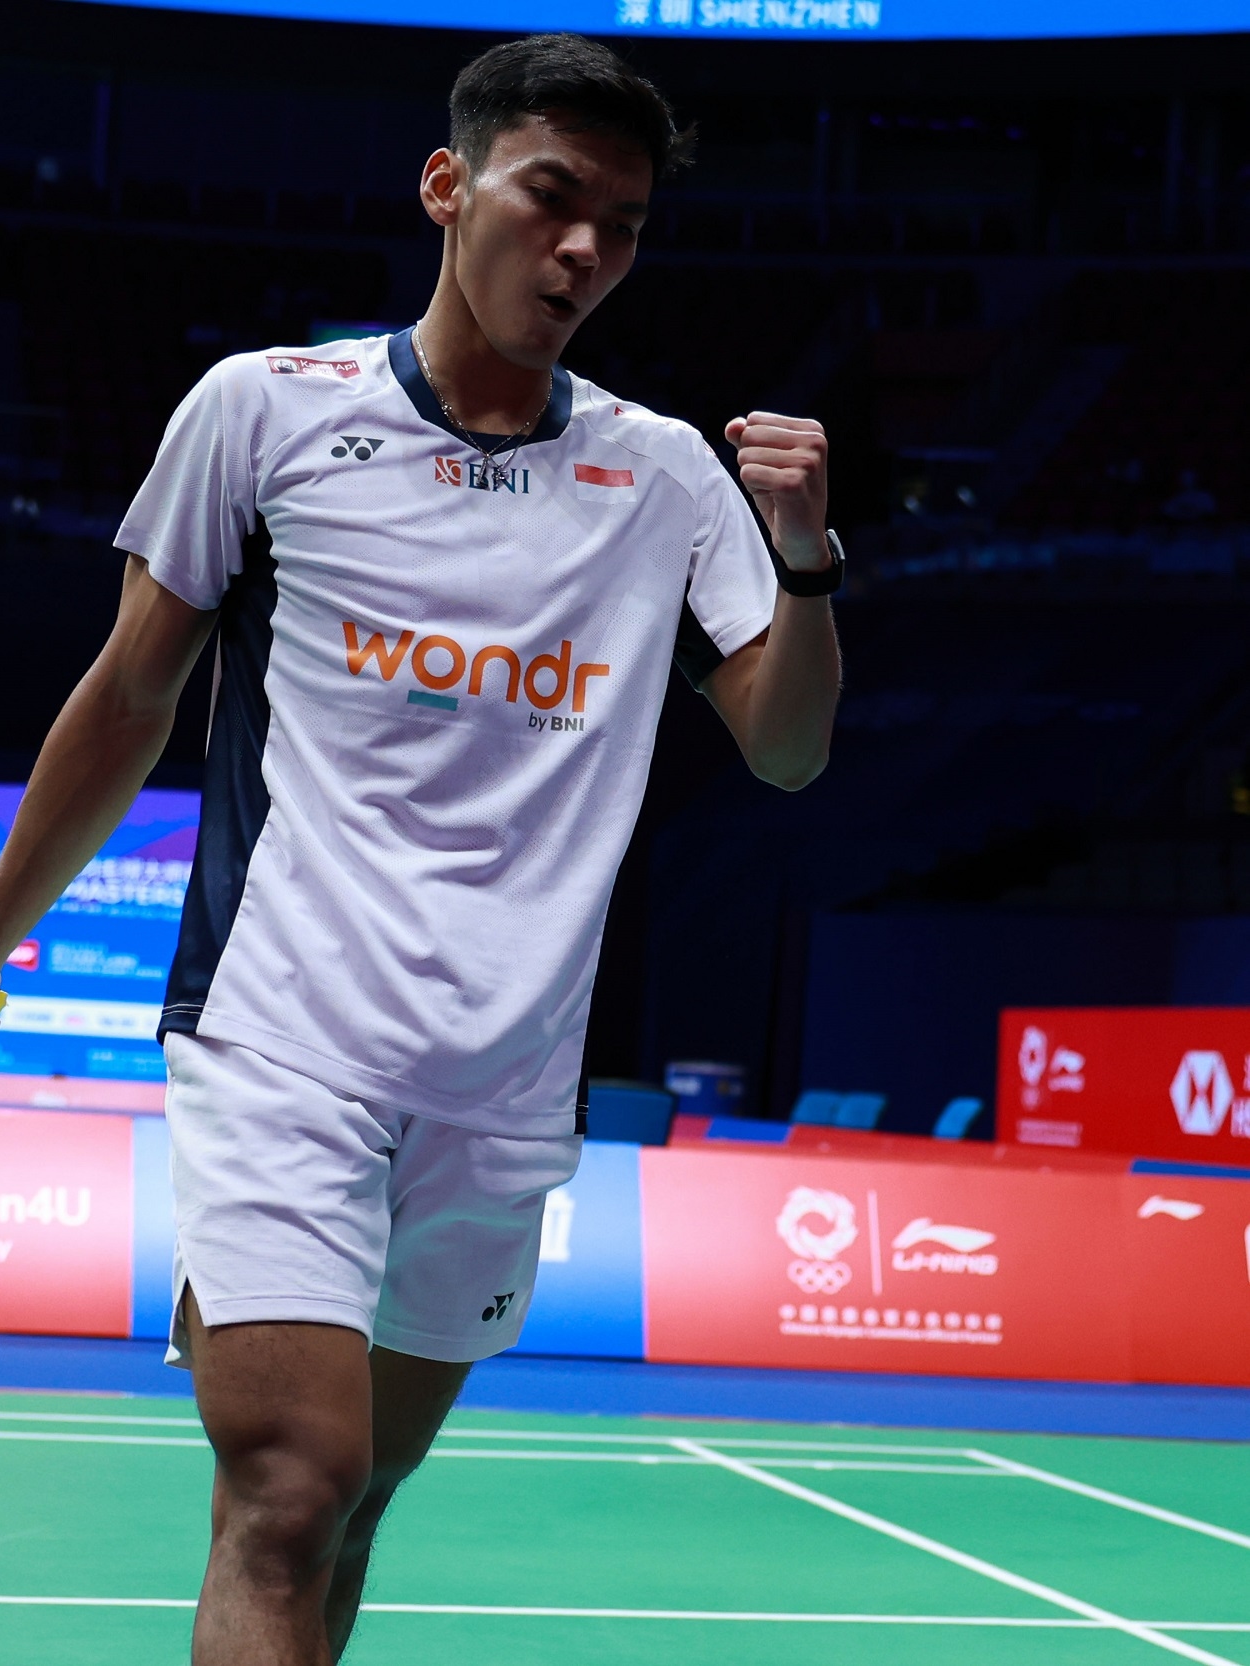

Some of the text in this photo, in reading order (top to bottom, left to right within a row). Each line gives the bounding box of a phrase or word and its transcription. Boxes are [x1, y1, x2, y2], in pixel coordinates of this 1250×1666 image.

[342, 621, 610, 713] wondr
[528, 712, 585, 732] by BNI
